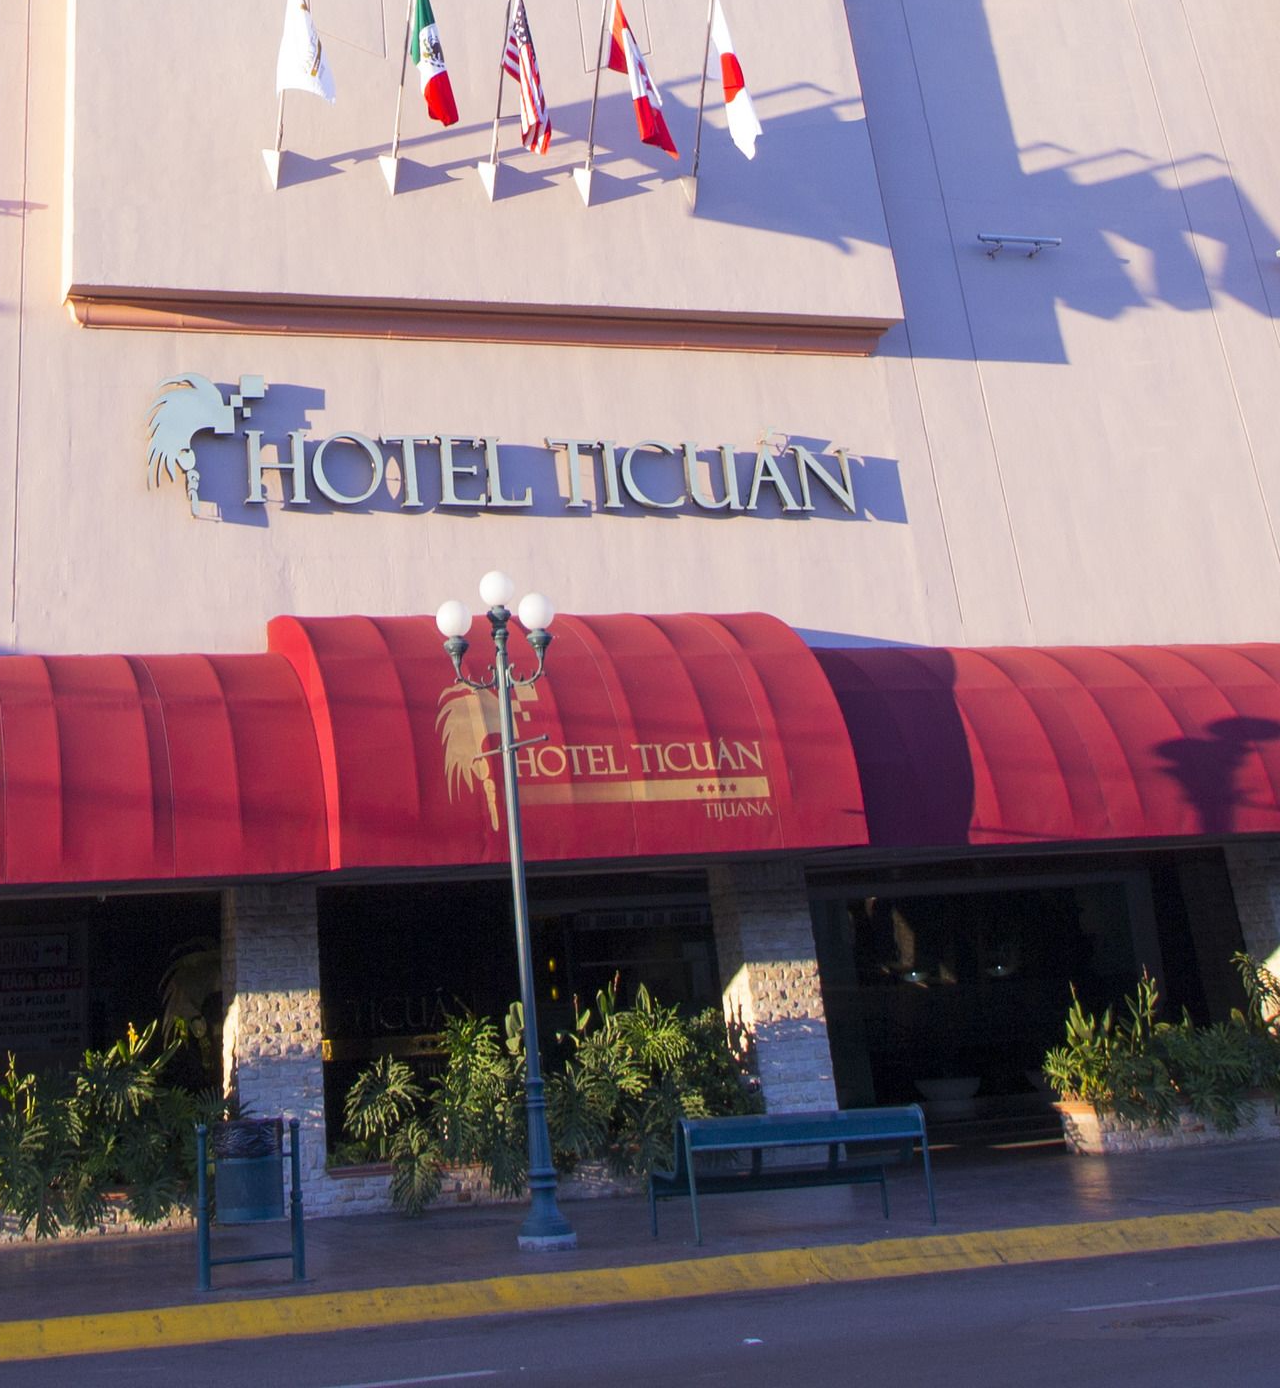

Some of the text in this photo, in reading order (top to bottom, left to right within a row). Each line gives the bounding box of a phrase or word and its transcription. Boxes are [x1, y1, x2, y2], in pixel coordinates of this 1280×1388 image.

[243, 429, 533, 508] HOTEL
[515, 737, 764, 778] HOTEL TICUÁN
[702, 800, 773, 821] TIJUANA
